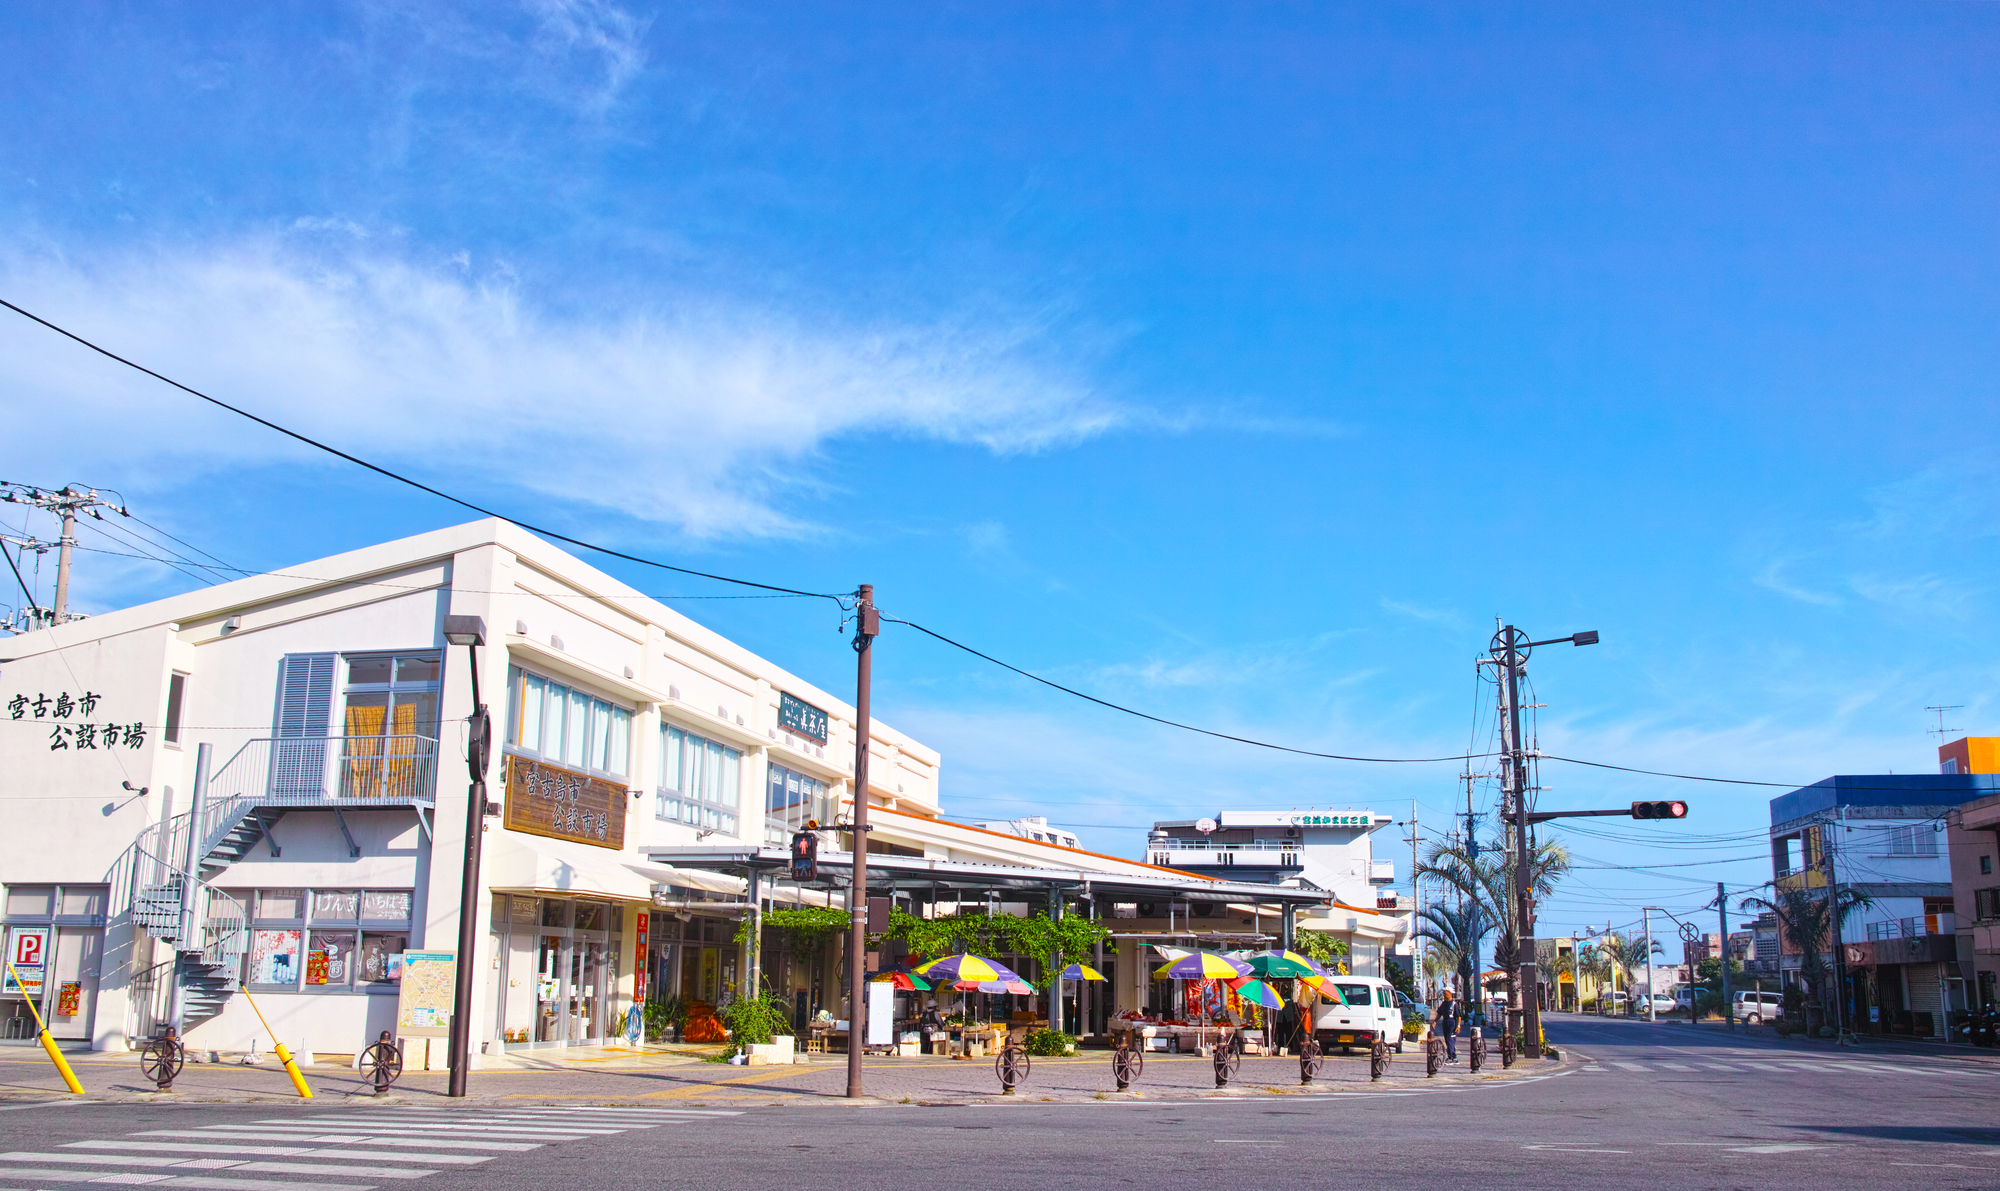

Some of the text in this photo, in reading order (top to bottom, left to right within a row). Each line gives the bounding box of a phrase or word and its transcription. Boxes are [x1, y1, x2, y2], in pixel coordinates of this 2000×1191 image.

[7, 691, 102, 721] 宮古島市
[49, 722, 147, 751] 公設市場
[526, 771, 581, 806] 宮古島市
[552, 803, 608, 840] 公設市場
